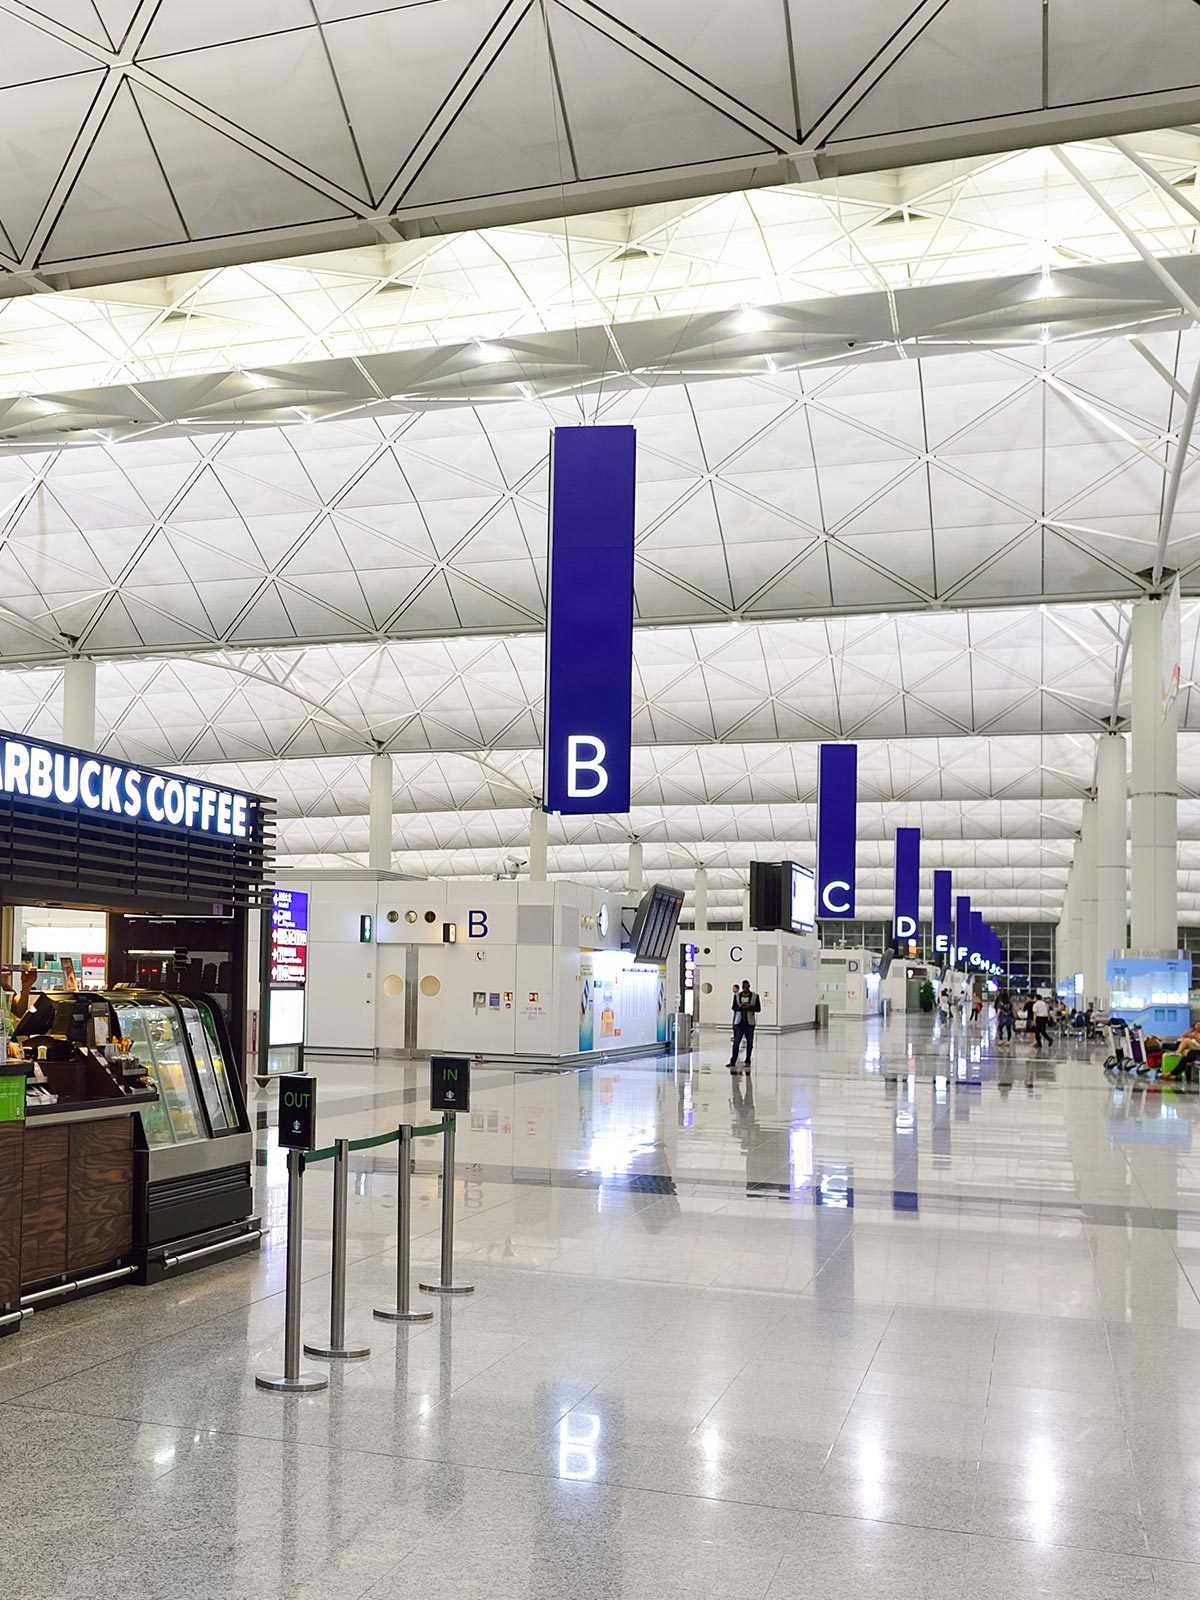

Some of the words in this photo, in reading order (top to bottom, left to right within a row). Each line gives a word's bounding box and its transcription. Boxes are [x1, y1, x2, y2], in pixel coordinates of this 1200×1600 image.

[567, 735, 609, 798] B
[146, 775, 248, 838] COFFEE
[822, 880, 851, 913] C
[468, 910, 489, 938] B
[896, 916, 917, 938] D
[935, 934, 949, 952] E
[730, 946, 743, 962] C
[957, 946, 968, 961] F
[969, 952, 982, 966] G
[848, 960, 859, 972] D
[980, 959, 990, 971] H
[443, 1068, 459, 1081] IN
[284, 1091, 311, 1108] OUT
